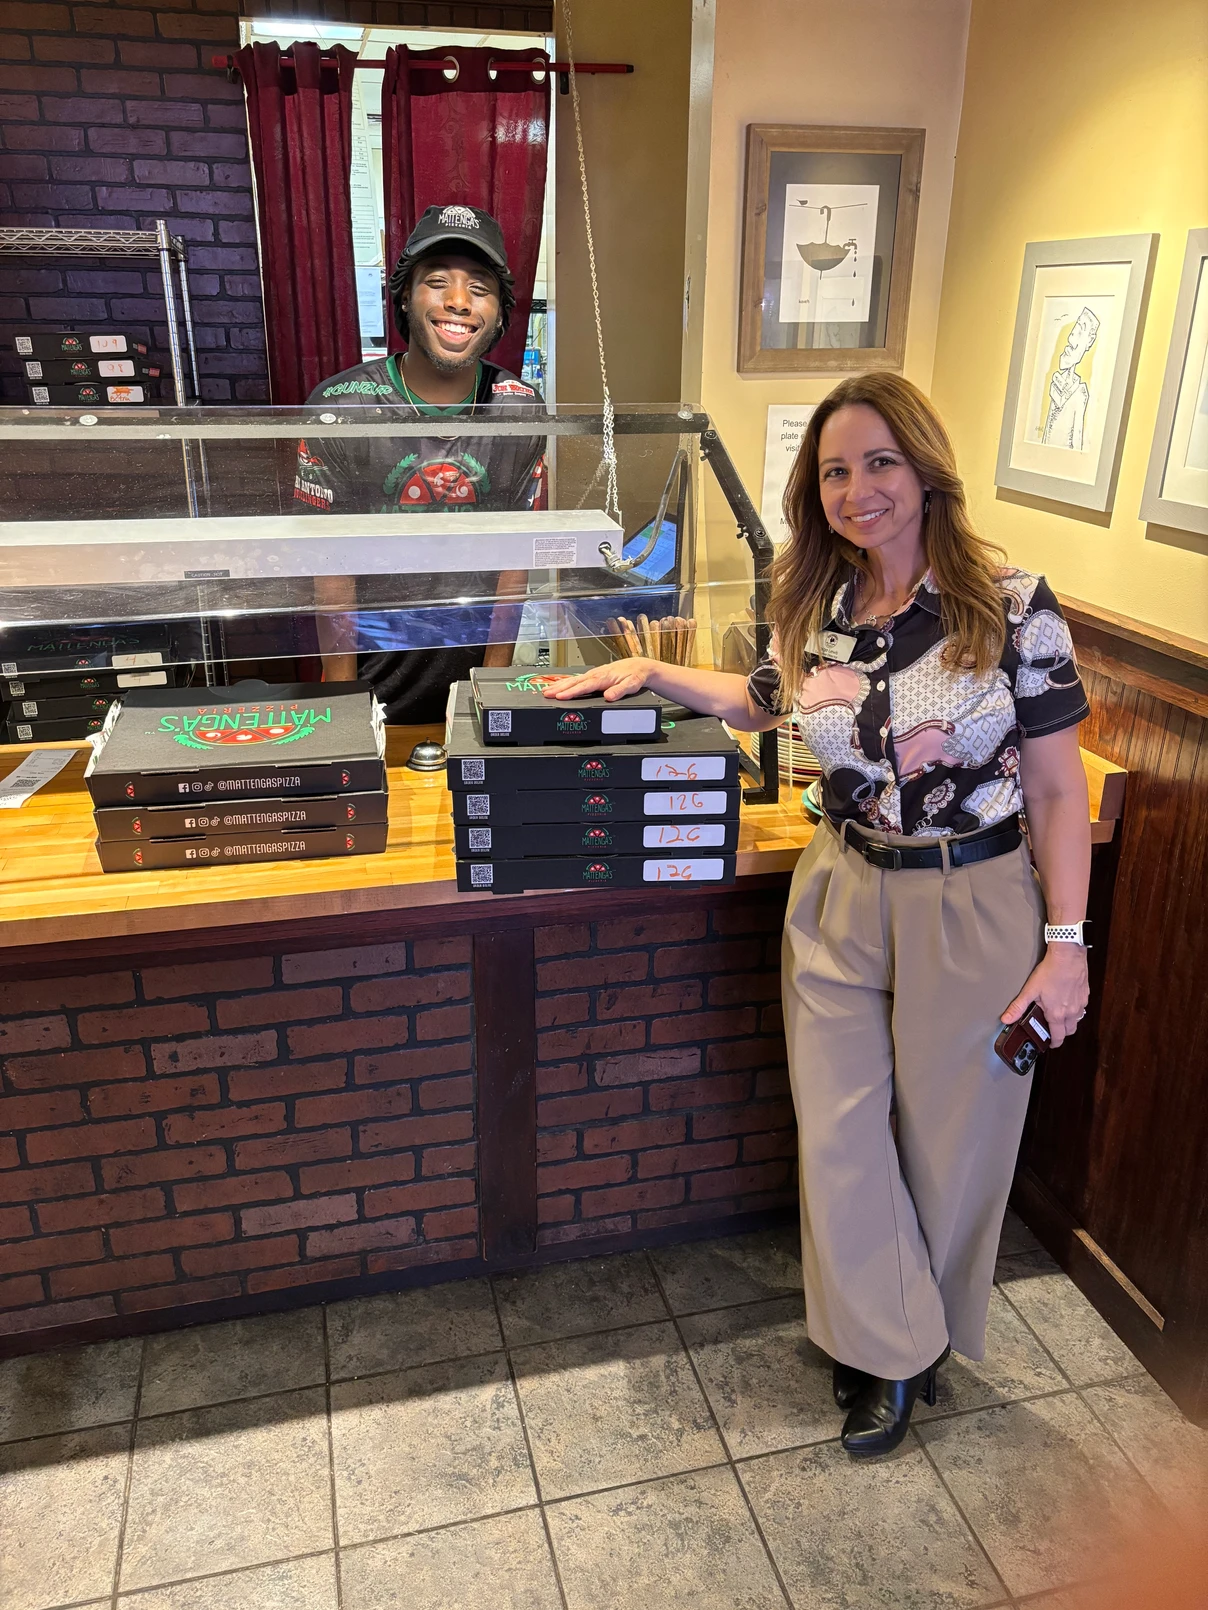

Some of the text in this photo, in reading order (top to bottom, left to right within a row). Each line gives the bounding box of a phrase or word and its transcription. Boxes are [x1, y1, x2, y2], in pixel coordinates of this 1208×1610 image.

[437, 212, 480, 229] MATTENGA'S
[782, 419, 808, 428] Please
[780, 432, 799, 441] plate
[198, 704, 298, 714] PIZZERIA
[158, 707, 331, 732] MATTENGA'S
[556, 721, 588, 731] MATTENGA'S
[578, 768, 610, 778] MATTENGA'S
[217, 776, 301, 791] @MATTENGASPIZZA
[581, 803, 613, 813] MATTENGA'S
[223, 811, 307, 825] @MATTENGASPIZZA
[581, 836, 613, 846] MATTENGA'S
[224, 841, 306, 856] @MATTENGASPIZZA
[582, 870, 613, 880] MATTENGA'S
